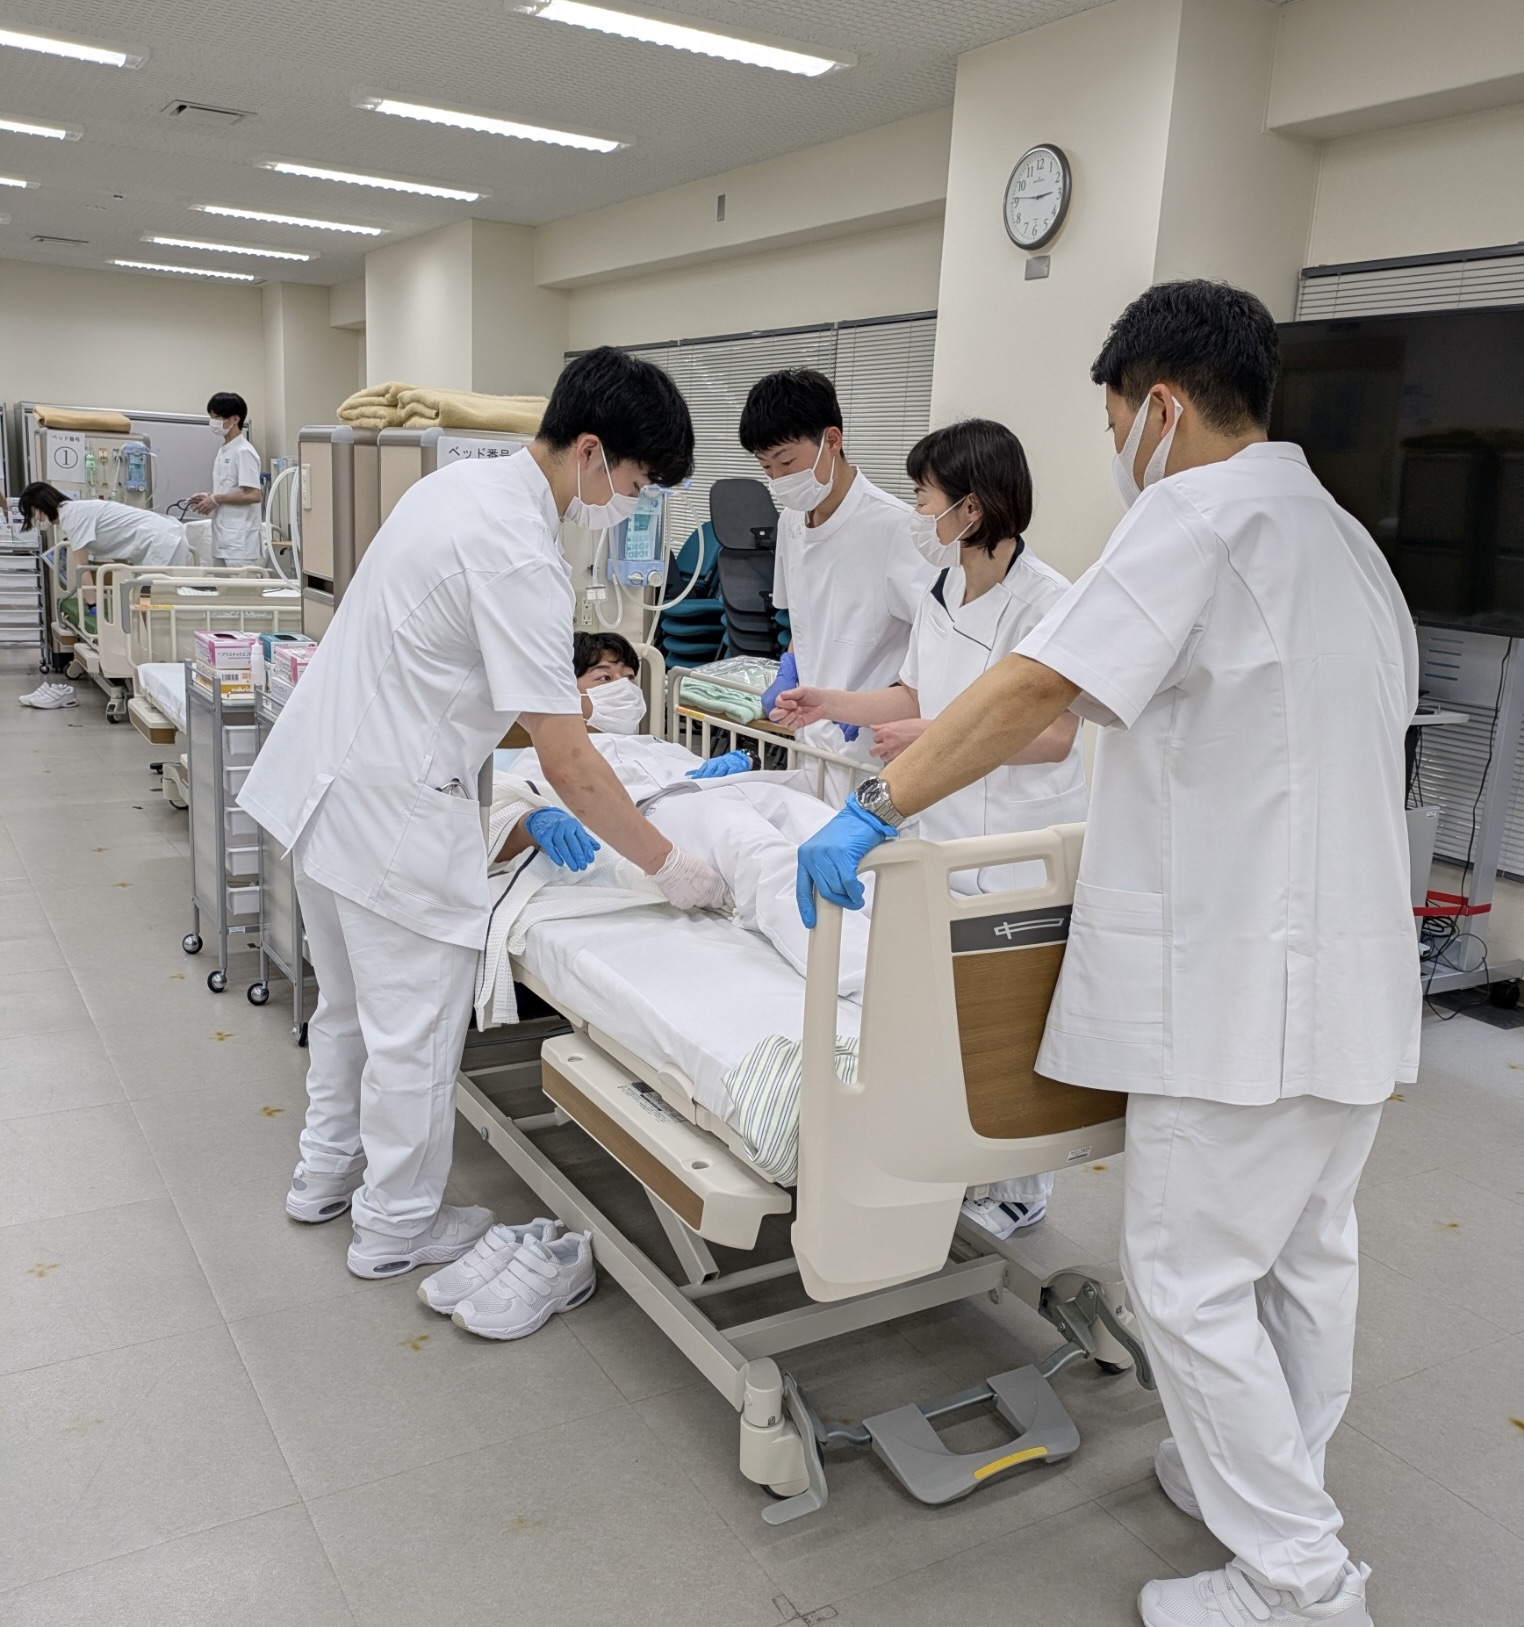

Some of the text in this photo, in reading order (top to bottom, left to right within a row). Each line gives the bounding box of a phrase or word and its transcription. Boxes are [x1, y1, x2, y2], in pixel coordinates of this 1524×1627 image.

[1036, 158, 1045, 170] 12
[1027, 166, 1034, 178] 11
[1055, 171, 1061, 183] 2
[1017, 180, 1026, 192] 10
[1014, 197, 1019, 209] 9
[1051, 204, 1056, 217] 4
[1016, 213, 1021, 224] 8
[1043, 218, 1049, 231] 5
[1024, 222, 1029, 234] 7
[1032, 224, 1037, 236] 6
[448, 446, 511, 459] ベッド番号
